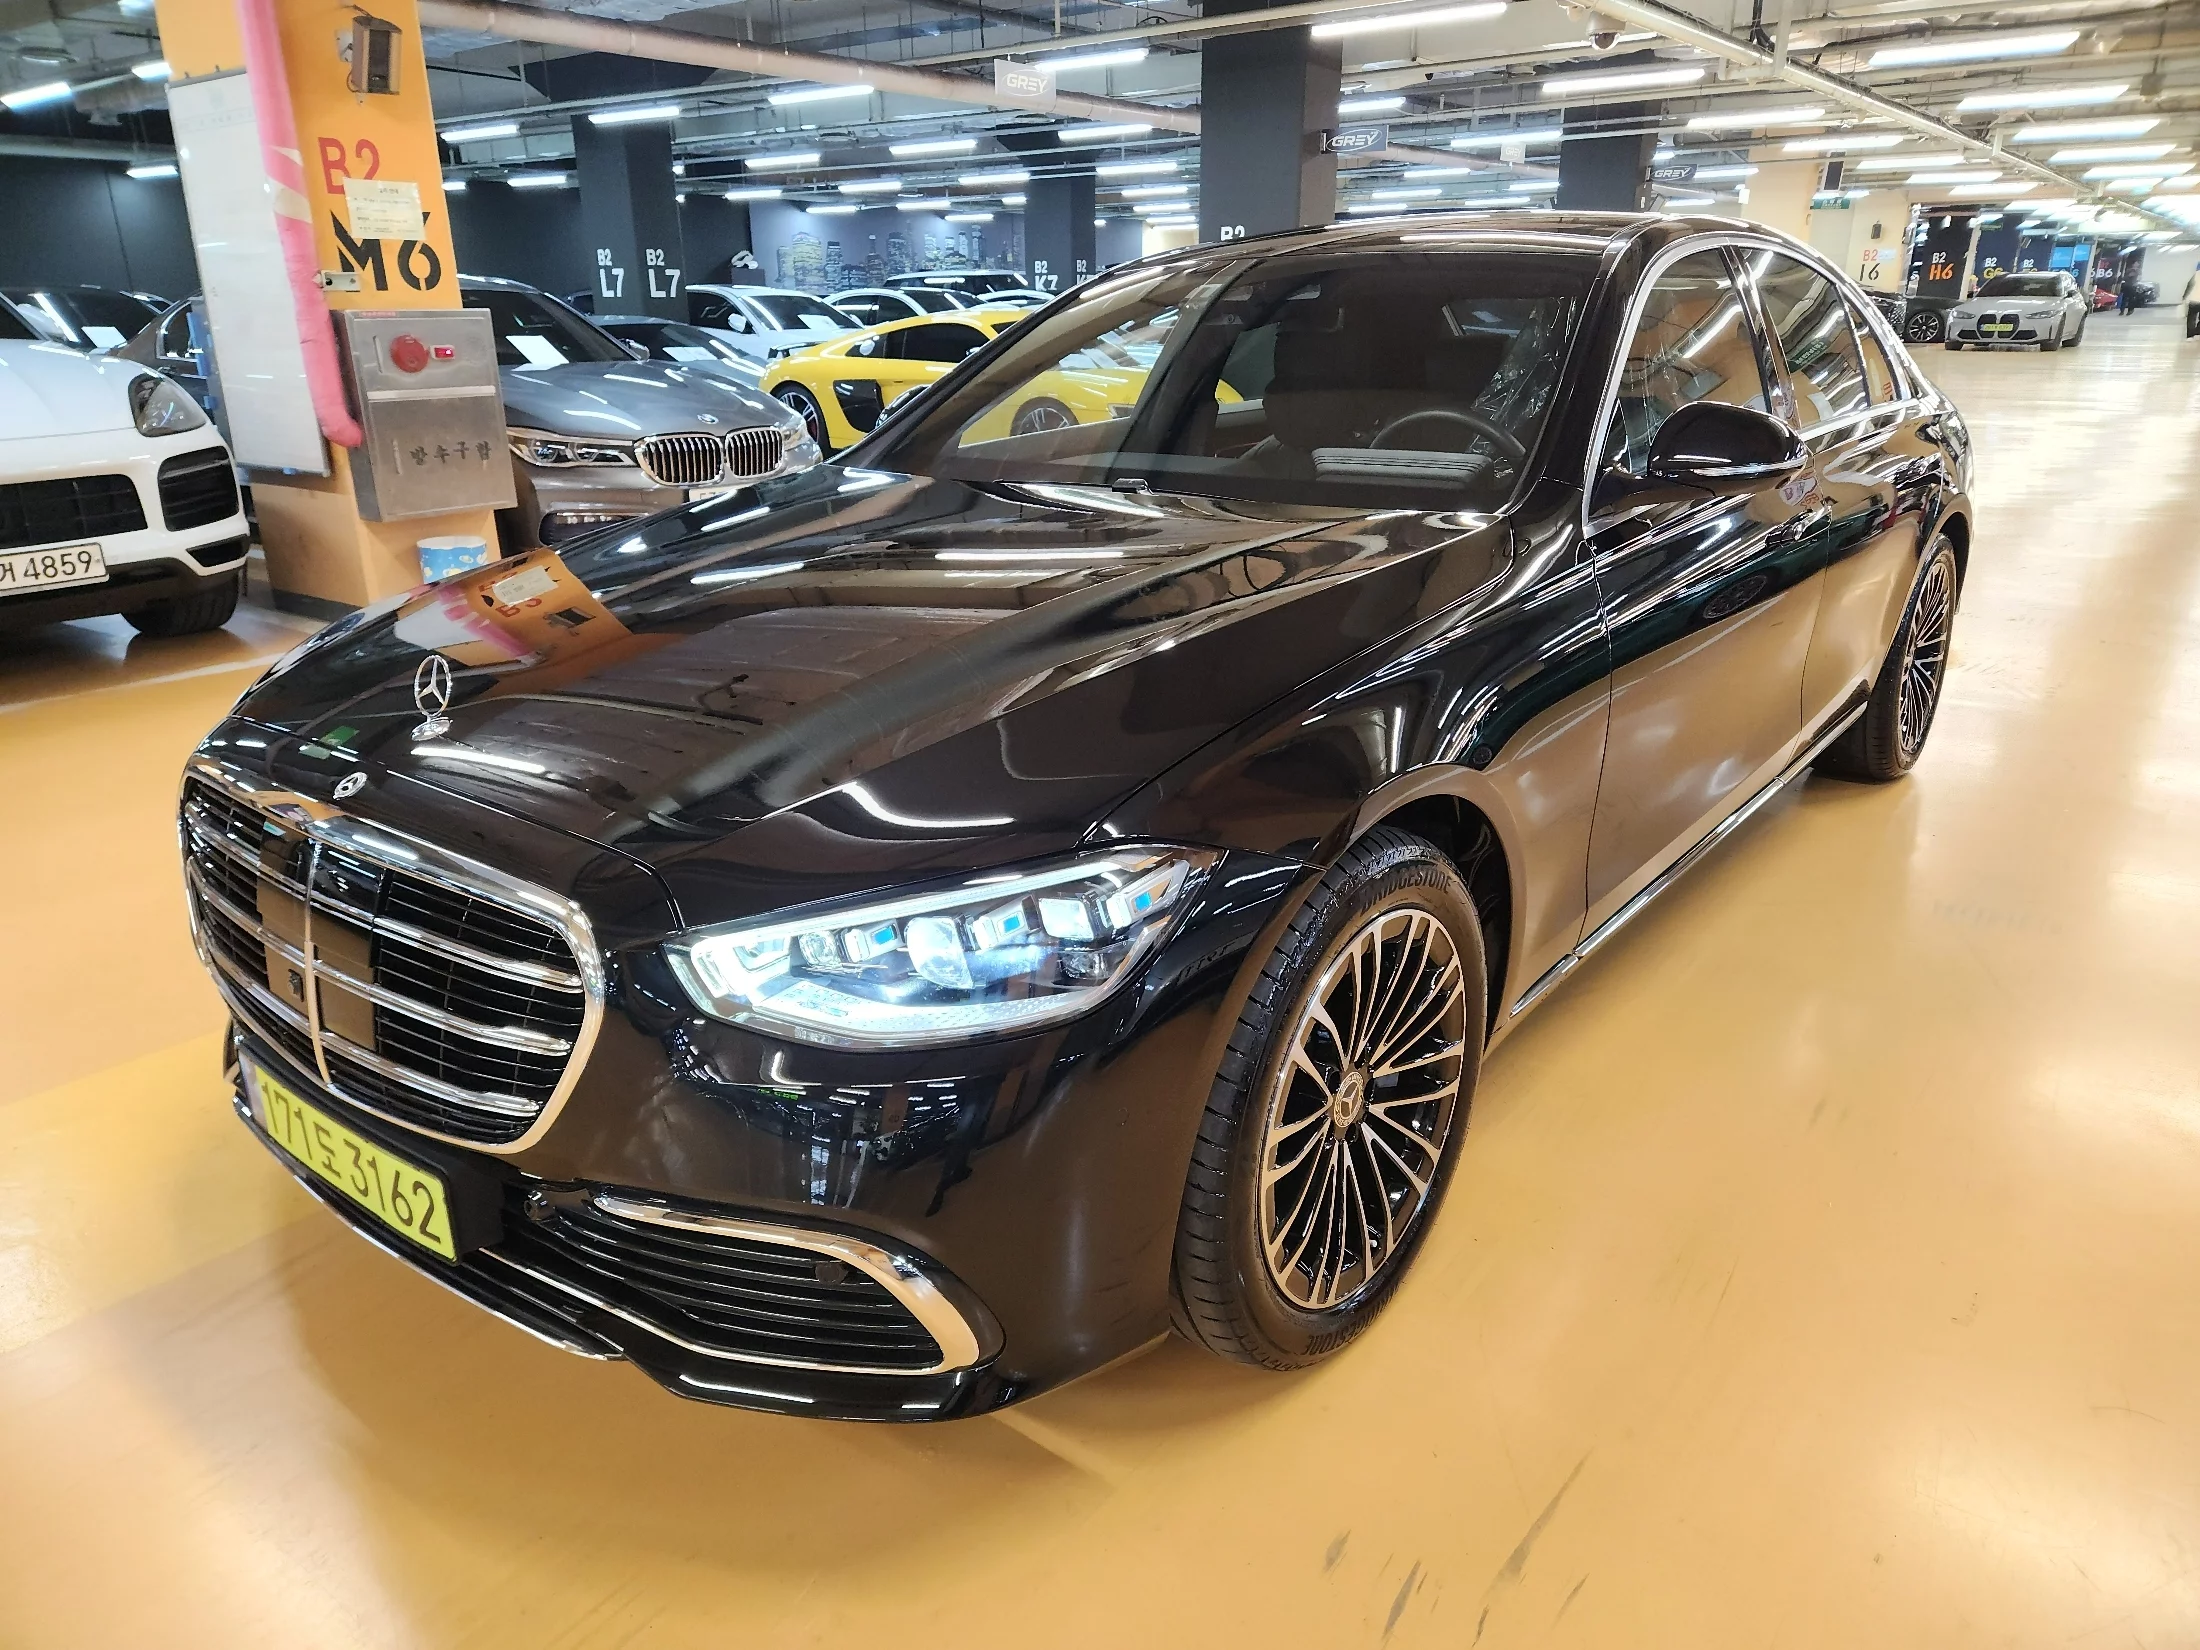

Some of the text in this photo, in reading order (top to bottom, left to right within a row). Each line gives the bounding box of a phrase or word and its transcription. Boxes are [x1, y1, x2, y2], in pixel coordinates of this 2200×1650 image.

[1006, 73, 1048, 93] GREY
[1331, 130, 1379, 147] GREY
[318, 137, 380, 195] B2
[1654, 167, 1691, 178] GREY
[330, 209, 442, 292] M6
[597, 248, 613, 266] B2
[645, 248, 665, 266] B2
[1863, 249, 1878, 261] B2
[1932, 251, 1946, 263] B2
[1034, 260, 1048, 274] B2
[1076, 259, 1087, 273] B2
[1985, 257, 1997, 267] B2
[2023, 259, 2034, 268] B2
[1076, 274, 1096, 286] K
[1929, 263, 1954, 280] H6
[600, 268, 624, 298] L7
[648, 268, 680, 298] L7
[1034, 275, 1058, 291] K7
[24, 550, 92, 580] 4859
